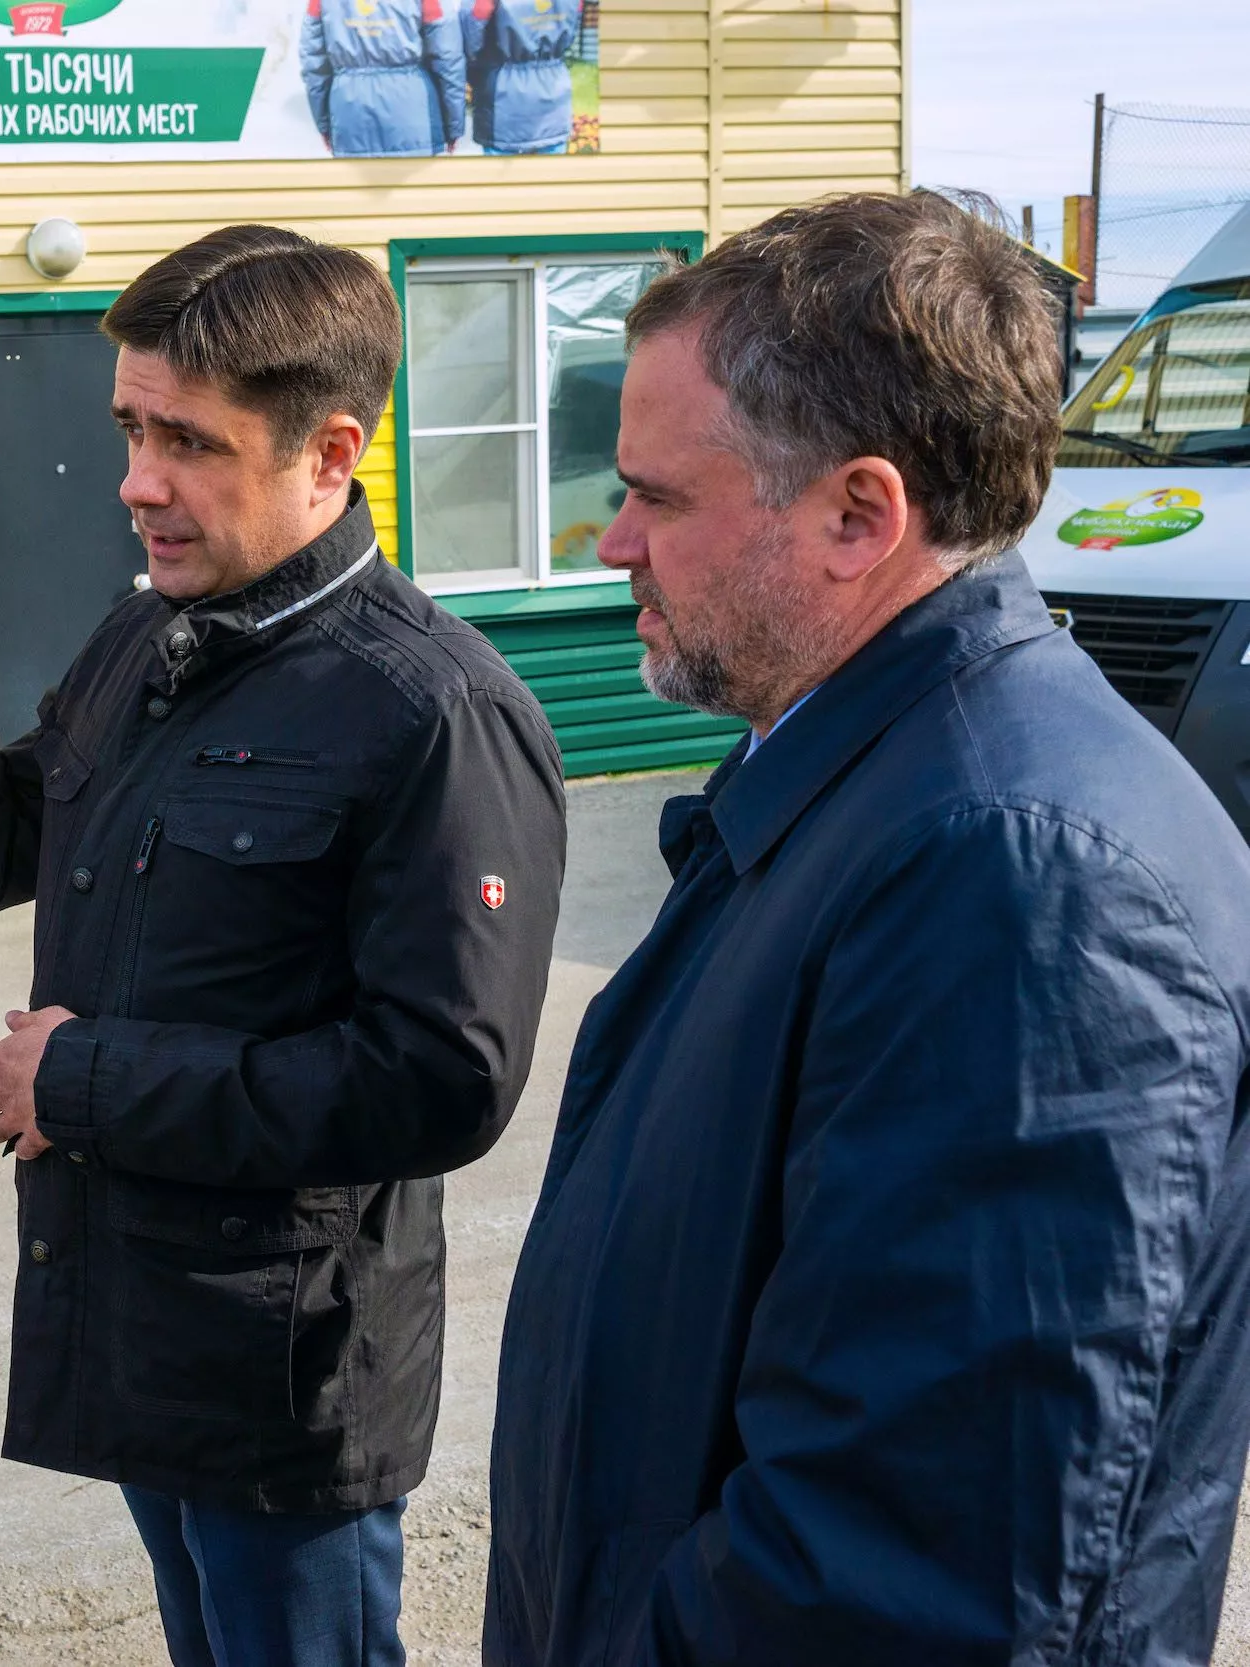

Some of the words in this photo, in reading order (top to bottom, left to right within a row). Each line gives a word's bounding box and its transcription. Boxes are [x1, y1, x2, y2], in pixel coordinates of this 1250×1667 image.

[24, 15, 54, 33] 1972
[4, 52, 134, 95] ТЫСЯЧИ
[25, 103, 133, 136] РАБОЧИХ
[137, 103, 198, 136] МЕСТ
